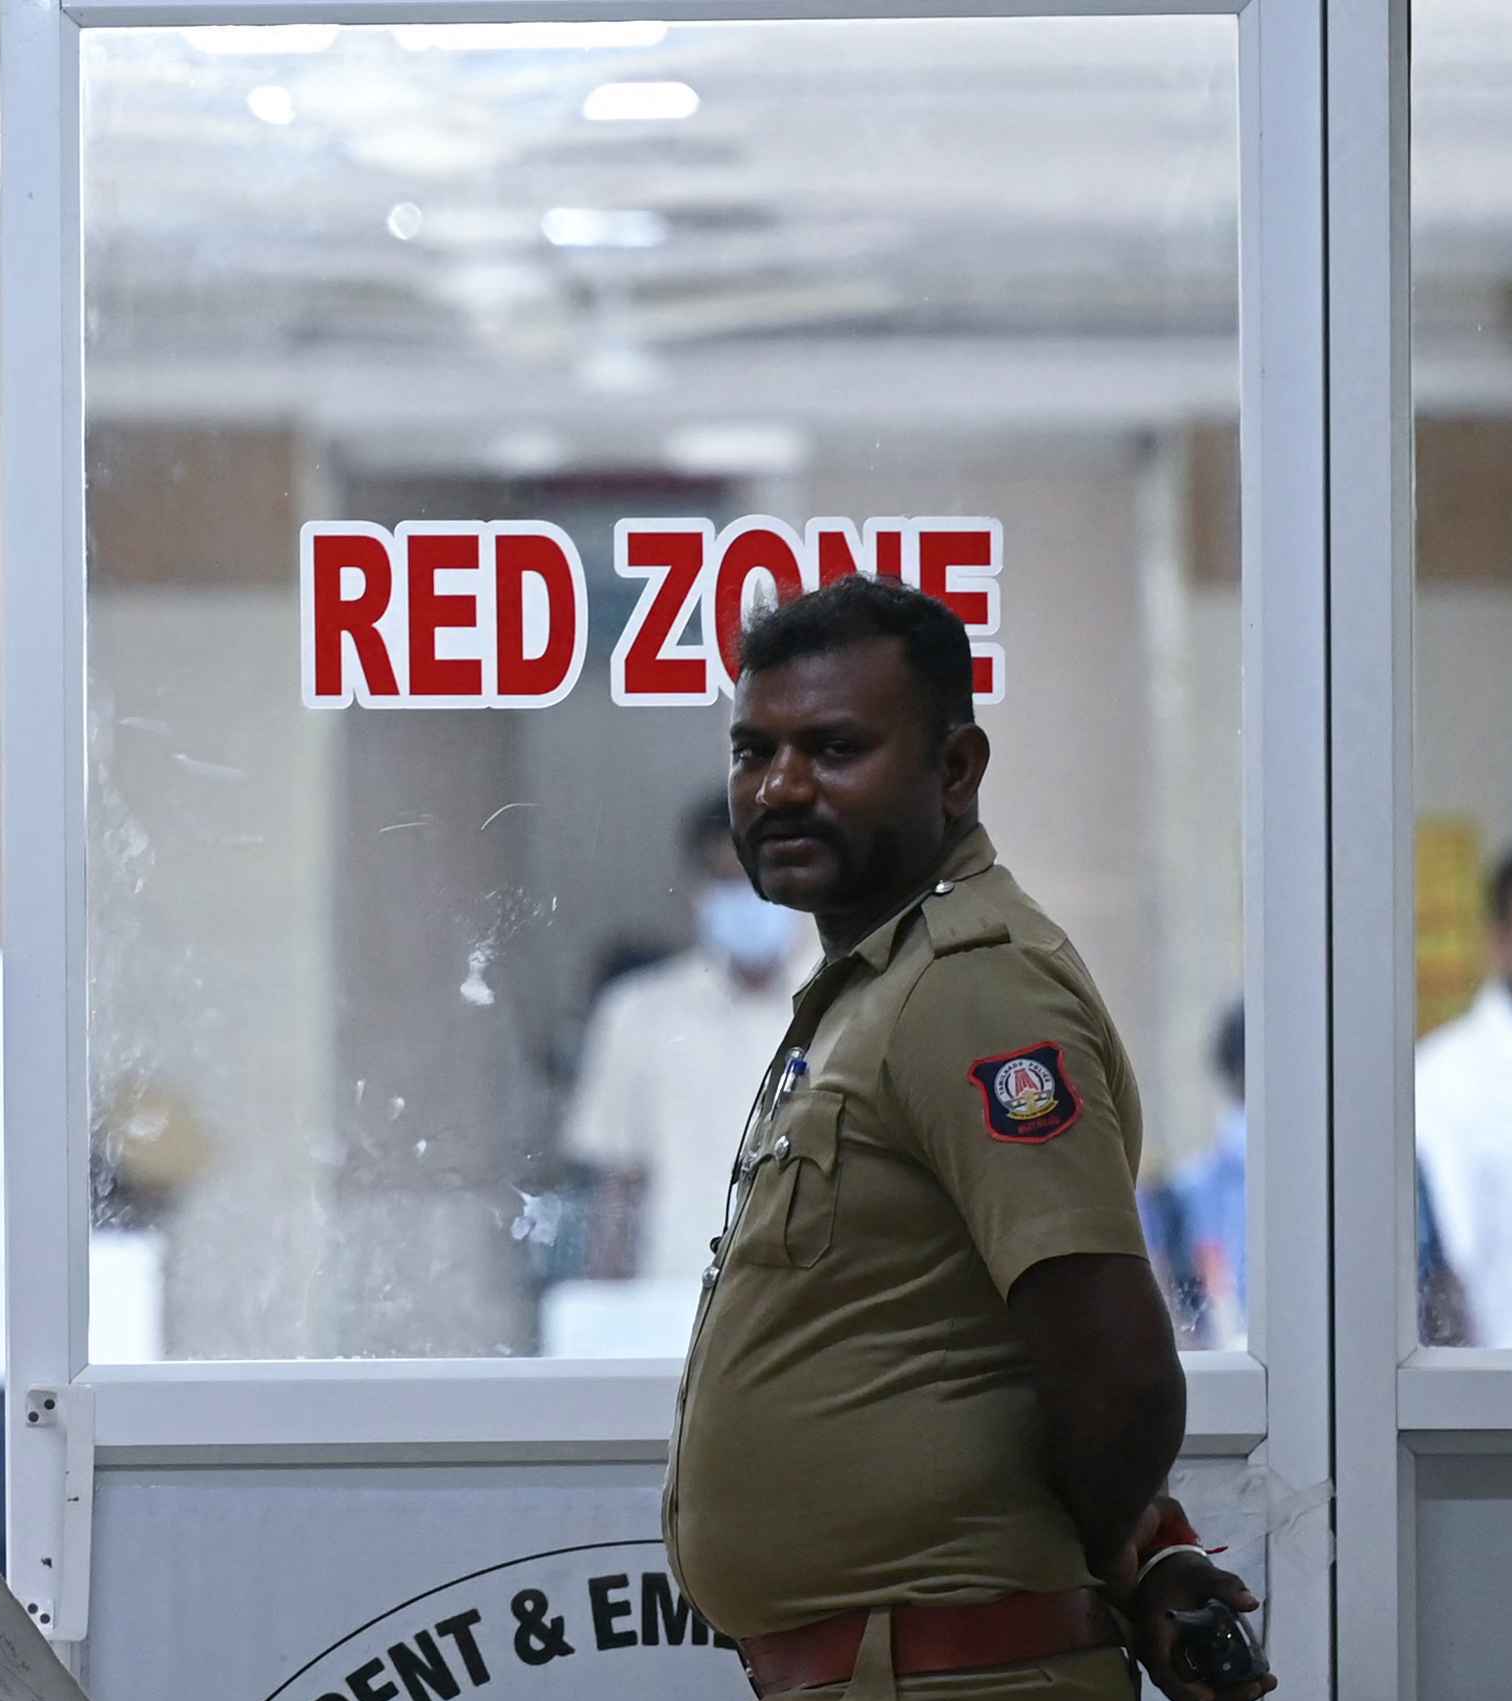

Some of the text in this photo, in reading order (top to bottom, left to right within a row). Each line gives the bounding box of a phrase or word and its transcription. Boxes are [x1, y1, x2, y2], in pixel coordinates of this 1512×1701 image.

[312, 533, 576, 697] RED
[511, 1589, 576, 1666] &
[587, 1571, 740, 1652] EM
